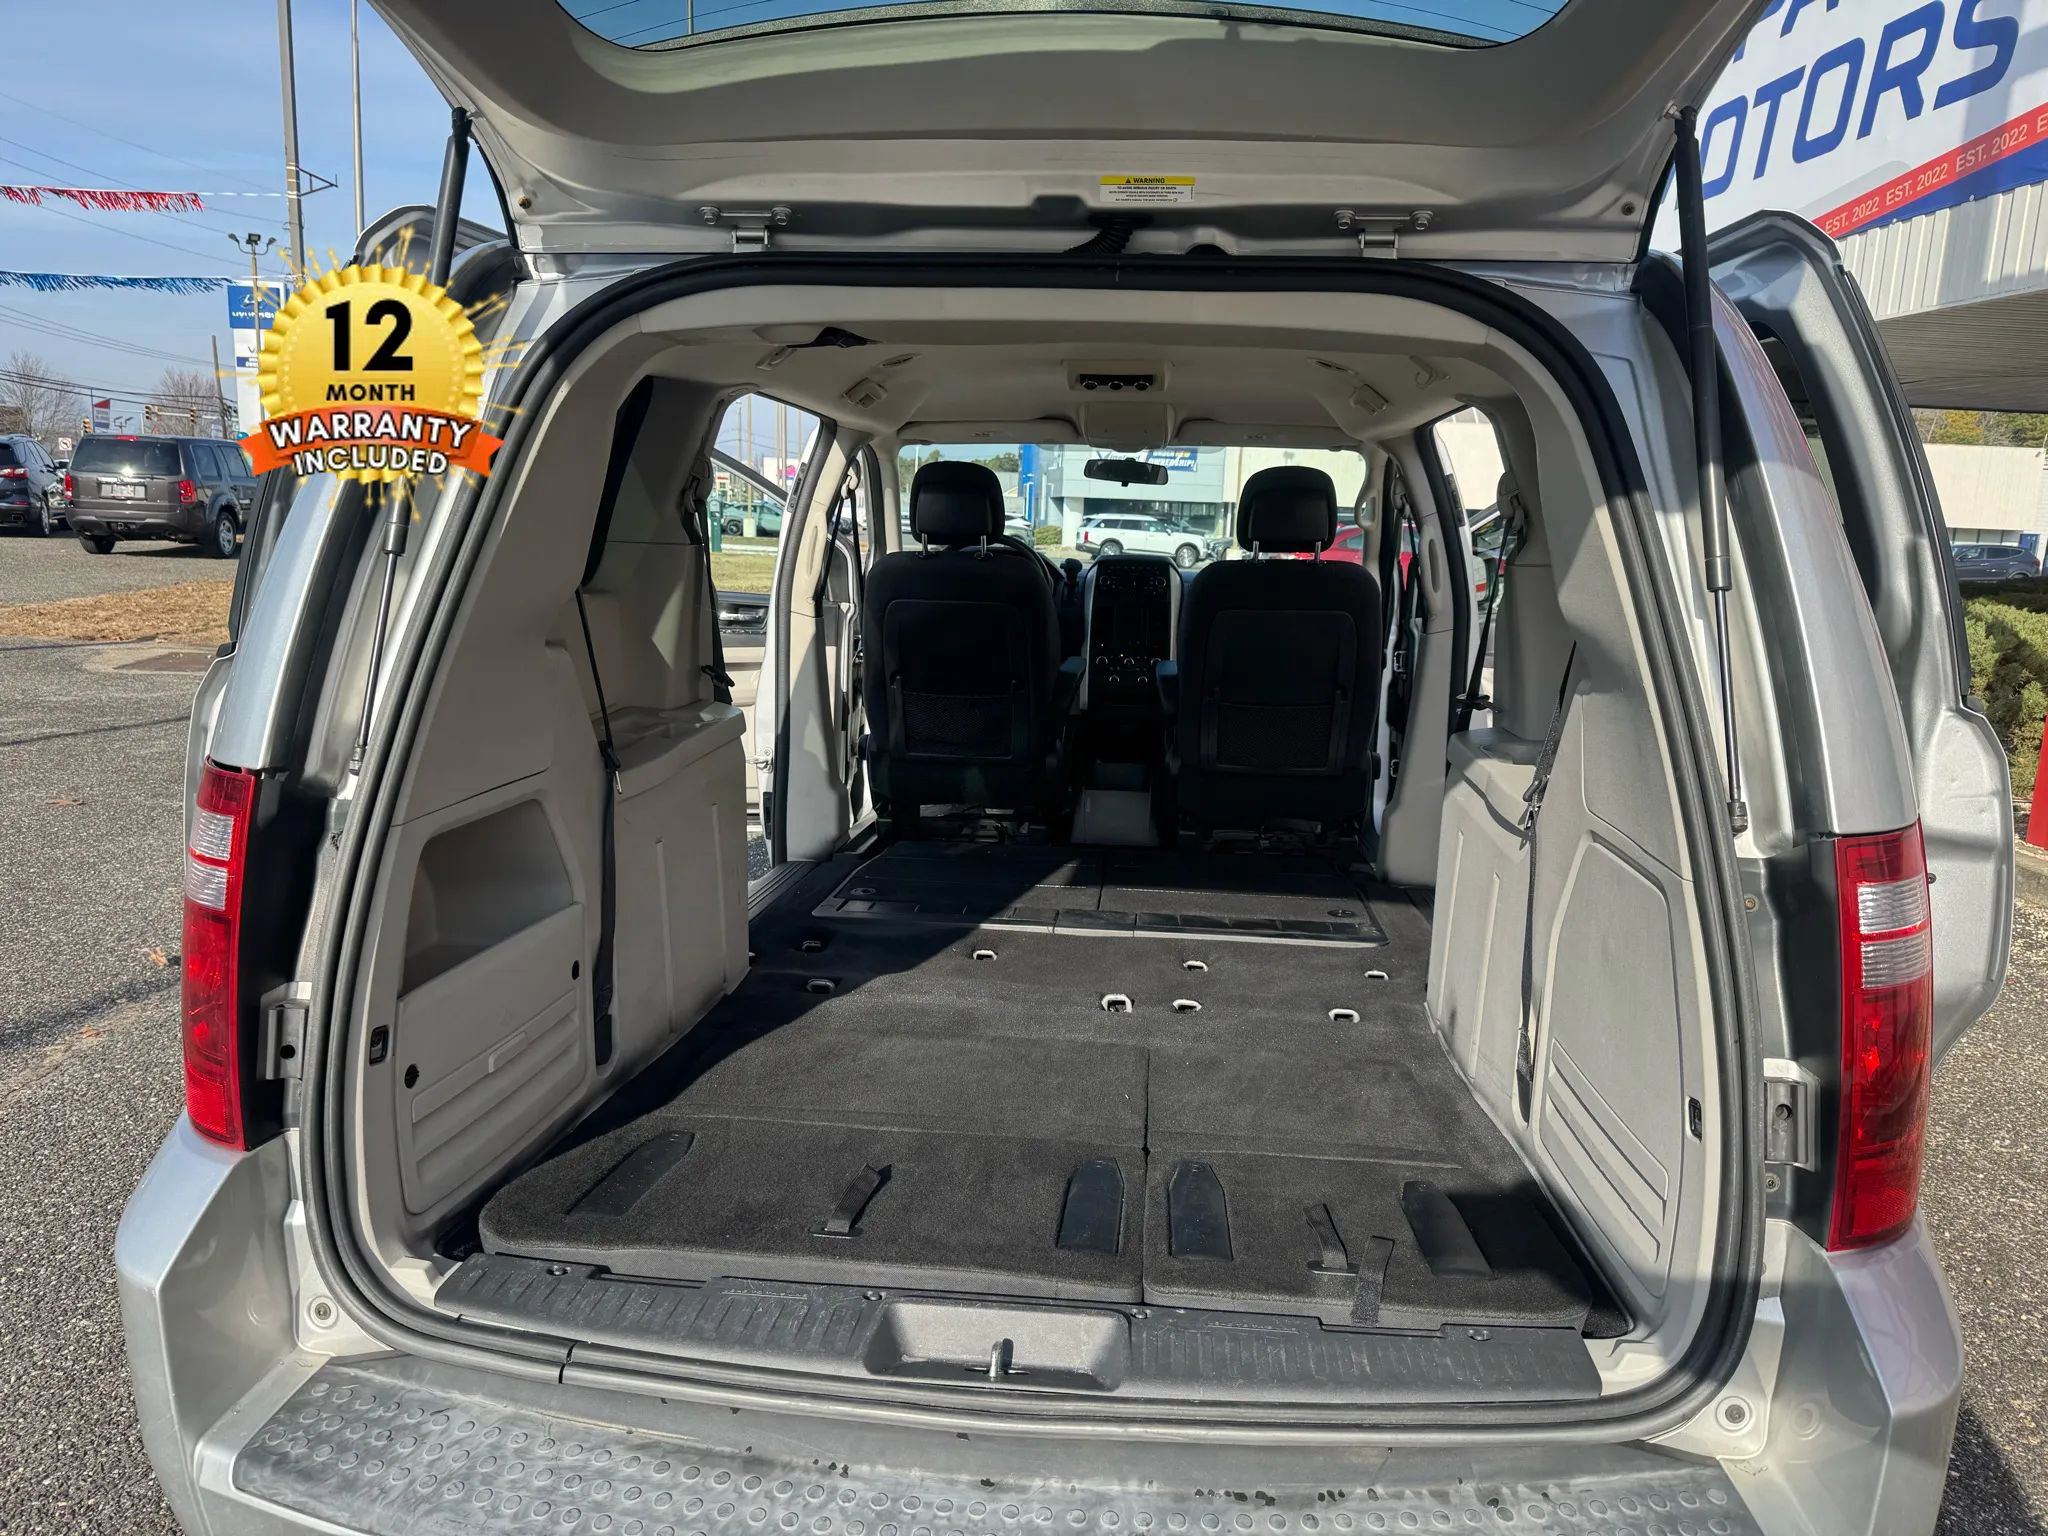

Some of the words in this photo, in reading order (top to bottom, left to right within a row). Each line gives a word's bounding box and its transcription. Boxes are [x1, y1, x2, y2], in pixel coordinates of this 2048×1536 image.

[1694, 0, 2019, 201] OTORS
[1825, 214, 1849, 234] EST.
[1852, 197, 1880, 221] 2022
[1886, 182, 1913, 206] EST.
[1917, 162, 1948, 189] 2022
[1955, 144, 1987, 173] EST.
[1991, 124, 2028, 155] 2022
